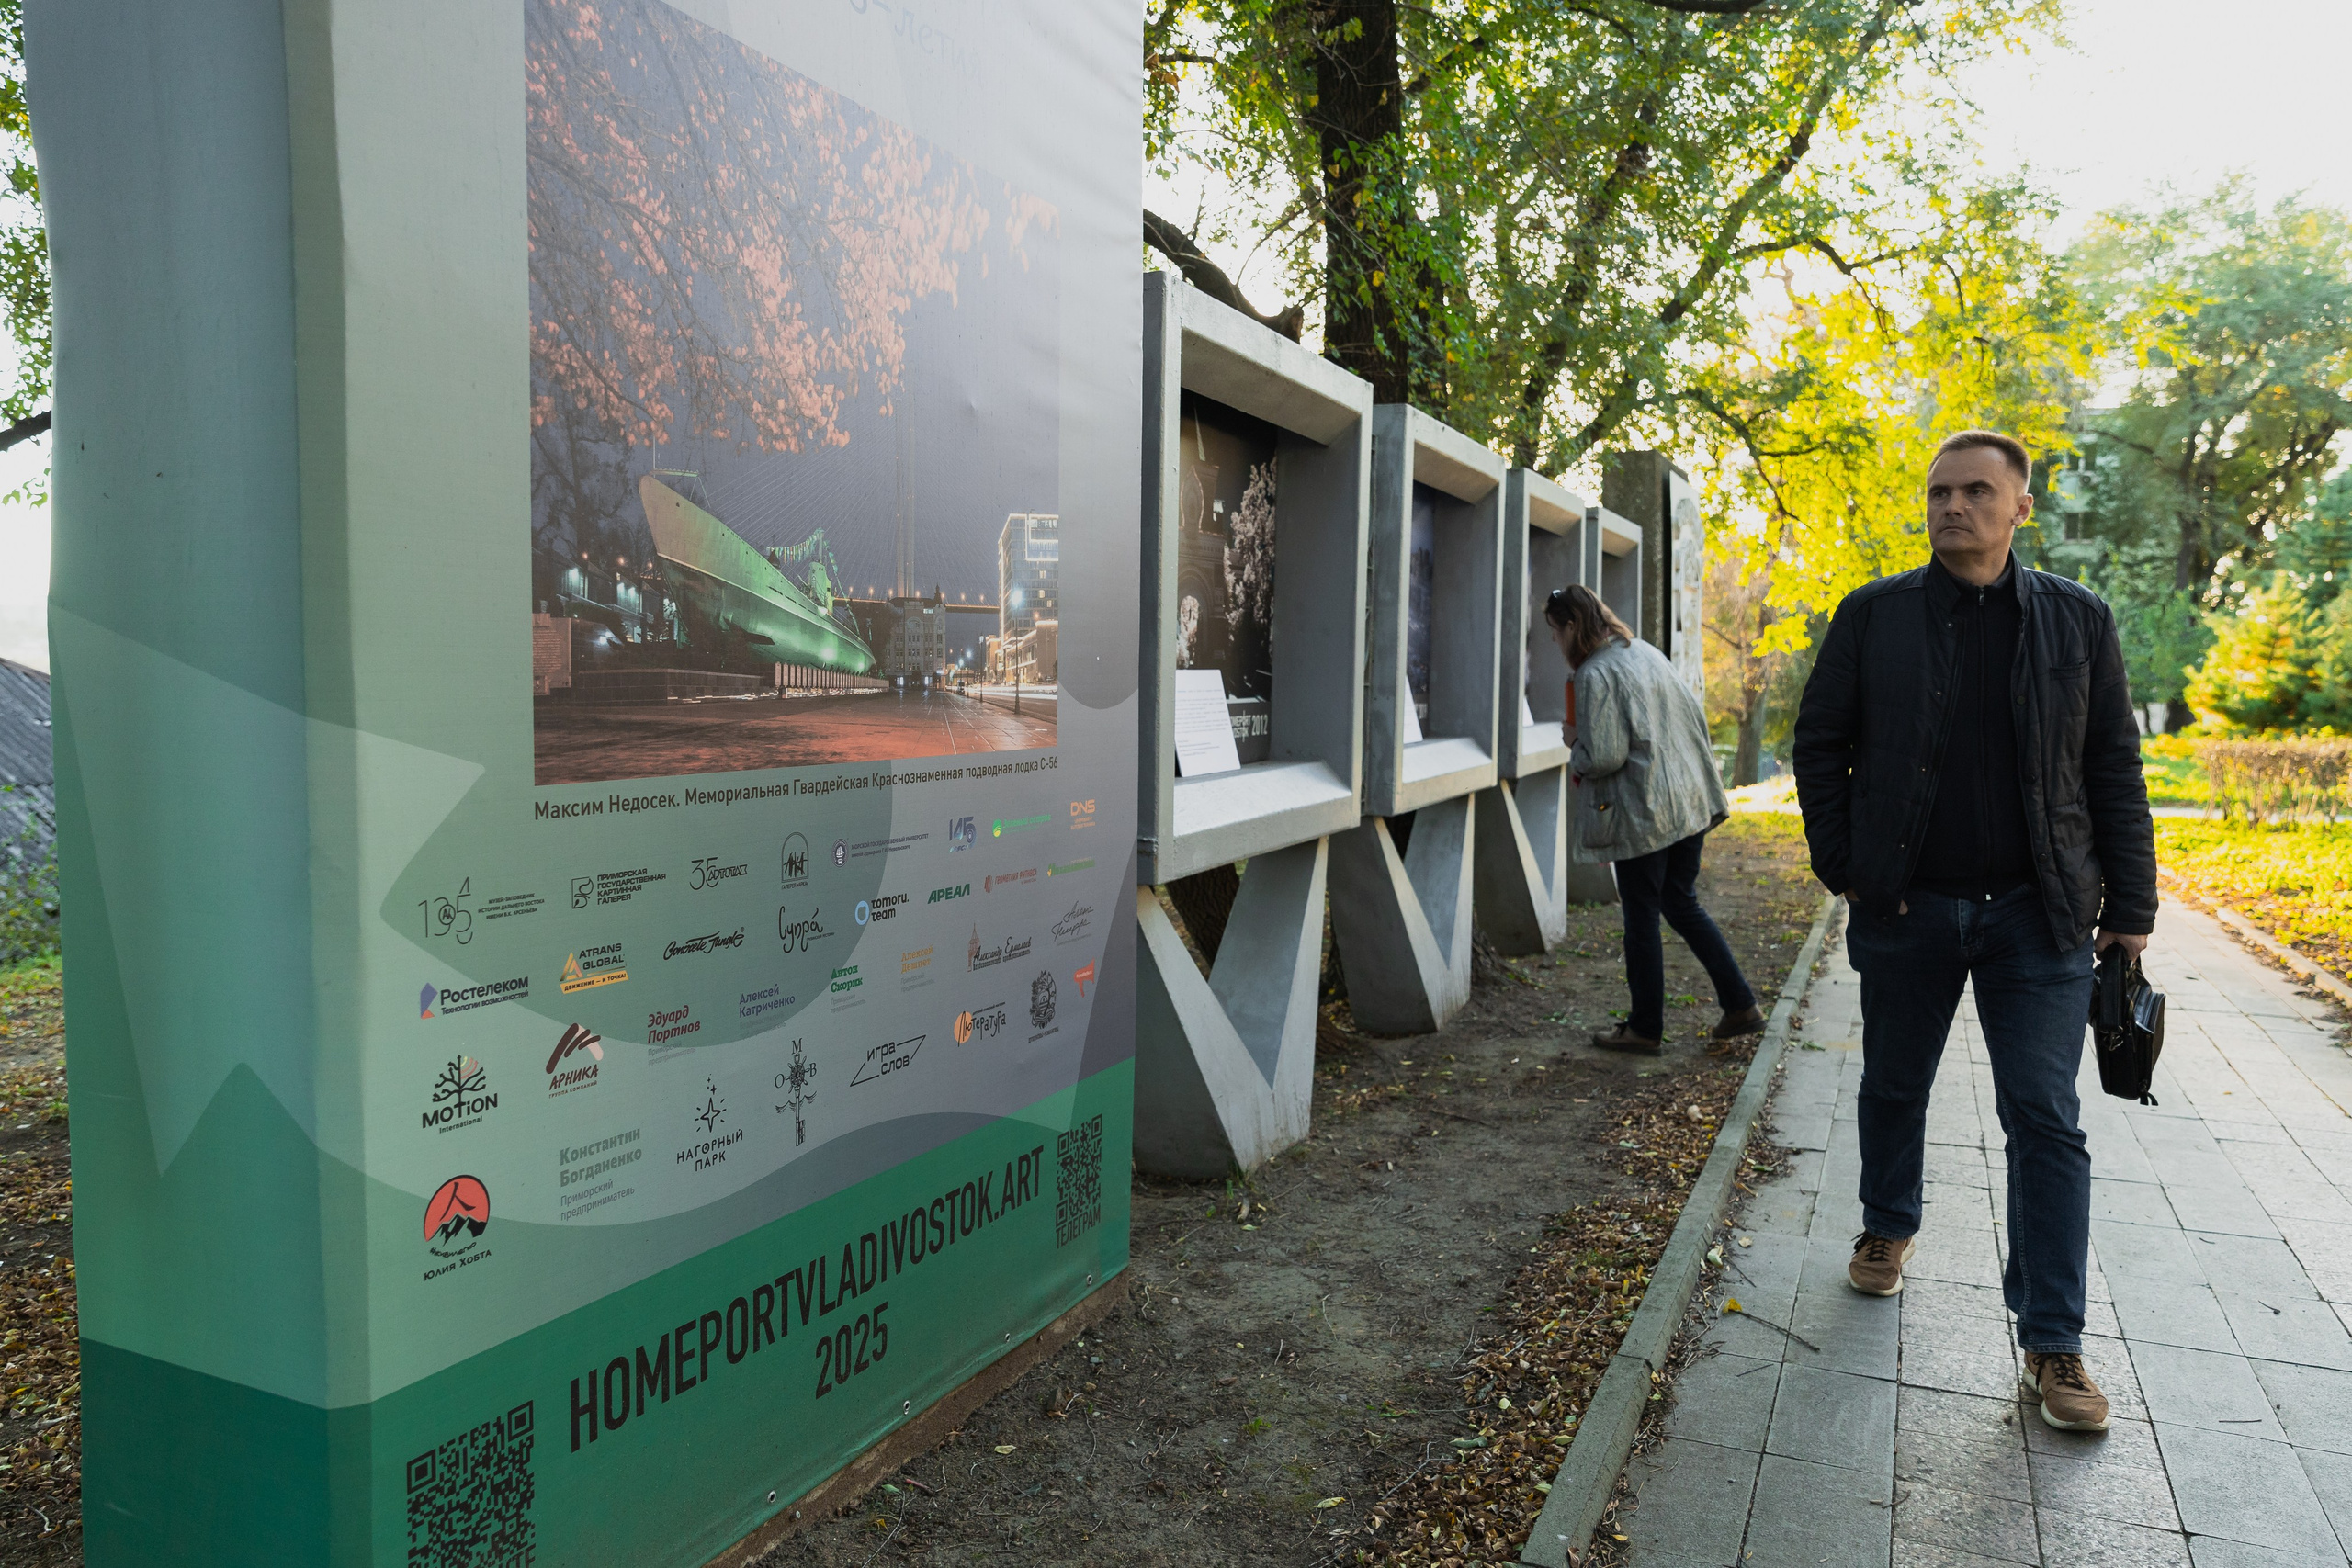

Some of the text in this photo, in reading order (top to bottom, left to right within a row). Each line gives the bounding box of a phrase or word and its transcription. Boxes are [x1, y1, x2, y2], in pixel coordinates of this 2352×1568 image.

[1251, 714, 1268, 736] 2012
[535, 756, 1058, 820] Максим Недосек. Мемориальная Гвардейская Краснознаменная подводная лодка С-56
[1070, 798, 1095, 816] DNS
[597, 868, 648, 881] ПРИМОРСКАЯ
[597, 874, 666, 889] ГОСУДАРСТВЕННАЯ
[690, 856, 718, 890] 35
[597, 885, 642, 897] КАРТИННАЯ
[597, 894, 631, 905] ГАЛЕРЕЯ
[871, 893, 909, 909] tomoru.
[927, 883, 970, 904] АРЕАЛ
[525, 898, 545, 908] ВОСТОКА
[871, 908, 896, 922] team
[579, 942, 622, 959] ATRANS
[901, 944, 933, 962] Алексей
[582, 954, 625, 970] GLOBAL
[831, 965, 858, 979] Антон
[440, 976, 529, 1005] Ростелеком
[564, 980, 594, 991] ДВИЖЕНИЕ
[607, 973, 627, 981] ТОЧКА!
[831, 977, 863, 993] Скорик
[442, 990, 529, 1015] Технологии возможностей
[739, 983, 780, 1005] Алексей
[647, 1004, 690, 1028] Эдуард
[739, 995, 796, 1019] Катриченко
[647, 1021, 701, 1044] Портнов
[866, 1041, 896, 1063] игра
[880, 1055, 910, 1076] слов
[549, 1064, 599, 1090] АРНИКА
[549, 1080, 598, 1099] ГРУППА КОМПАНИЙ
[438, 1115, 483, 1134] International
[560, 1128, 640, 1167] Константин
[676, 1128, 744, 1164] НАГОРНЫЙ
[560, 1149, 642, 1188] Богданенко
[695, 1150, 726, 1172] ПАРК
[560, 1179, 614, 1207] Приморский
[560, 1186, 636, 1222] предприниматель
[1056, 1202, 1101, 1250] ТЕЛЕГРАМ
[570, 1145, 1045, 1454] HOMEPORTVLADIVOSTOK.ART
[814, 1301, 888, 1400] 2025
